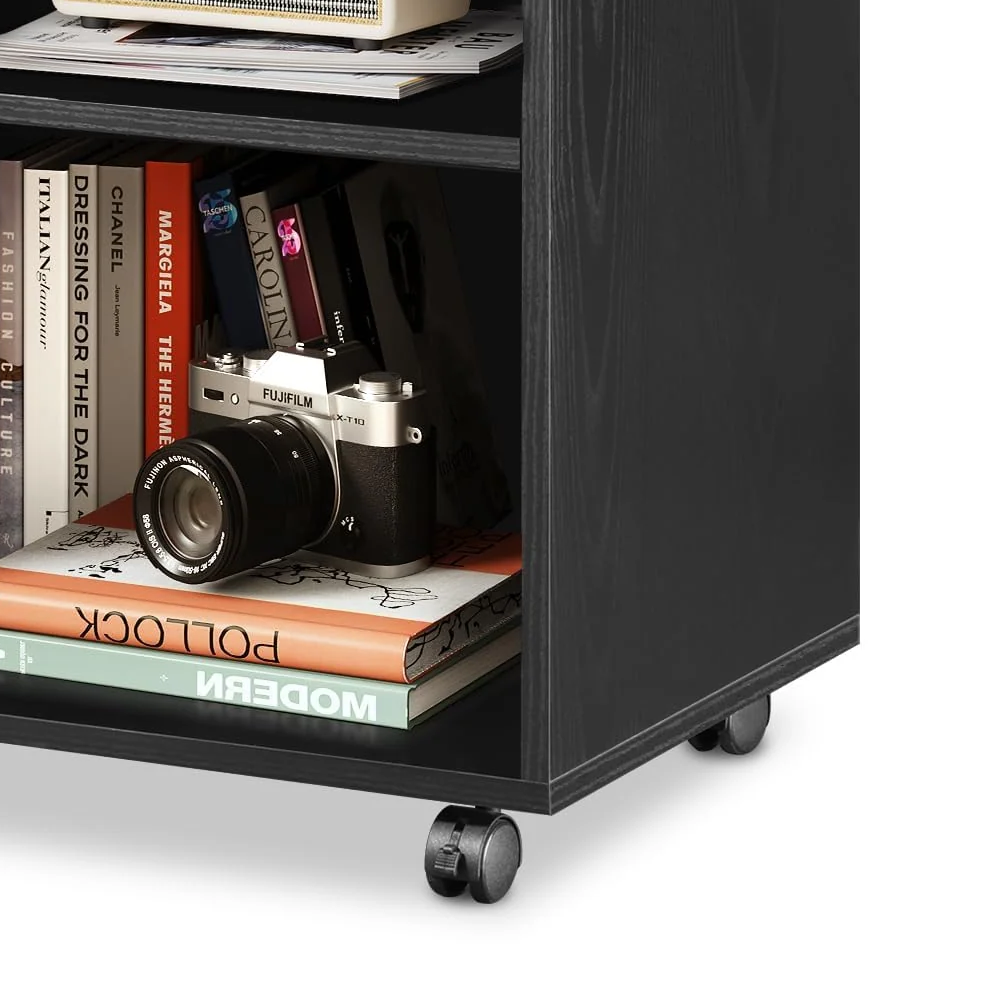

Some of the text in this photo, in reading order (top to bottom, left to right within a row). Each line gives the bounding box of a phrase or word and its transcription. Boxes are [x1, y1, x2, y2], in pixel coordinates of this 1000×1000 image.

[111, 186, 123, 273] CHANEL
[202, 204, 233, 217] TASCHEN
[74, 175, 89, 301] DRESSING
[0, 231, 15, 475] FASHION CULTURE
[74, 311, 89, 361] FOR
[158, 210, 175, 449] MARGIELA THE HERMÈ
[74, 369, 89, 419] THE
[263, 387, 314, 409] FUJIFILM
[336, 413, 365, 426] X-T10
[74, 428, 89, 498] DARK
[143, 458, 168, 490] FUJINON
[75, 606, 280, 664] POLLOCK
